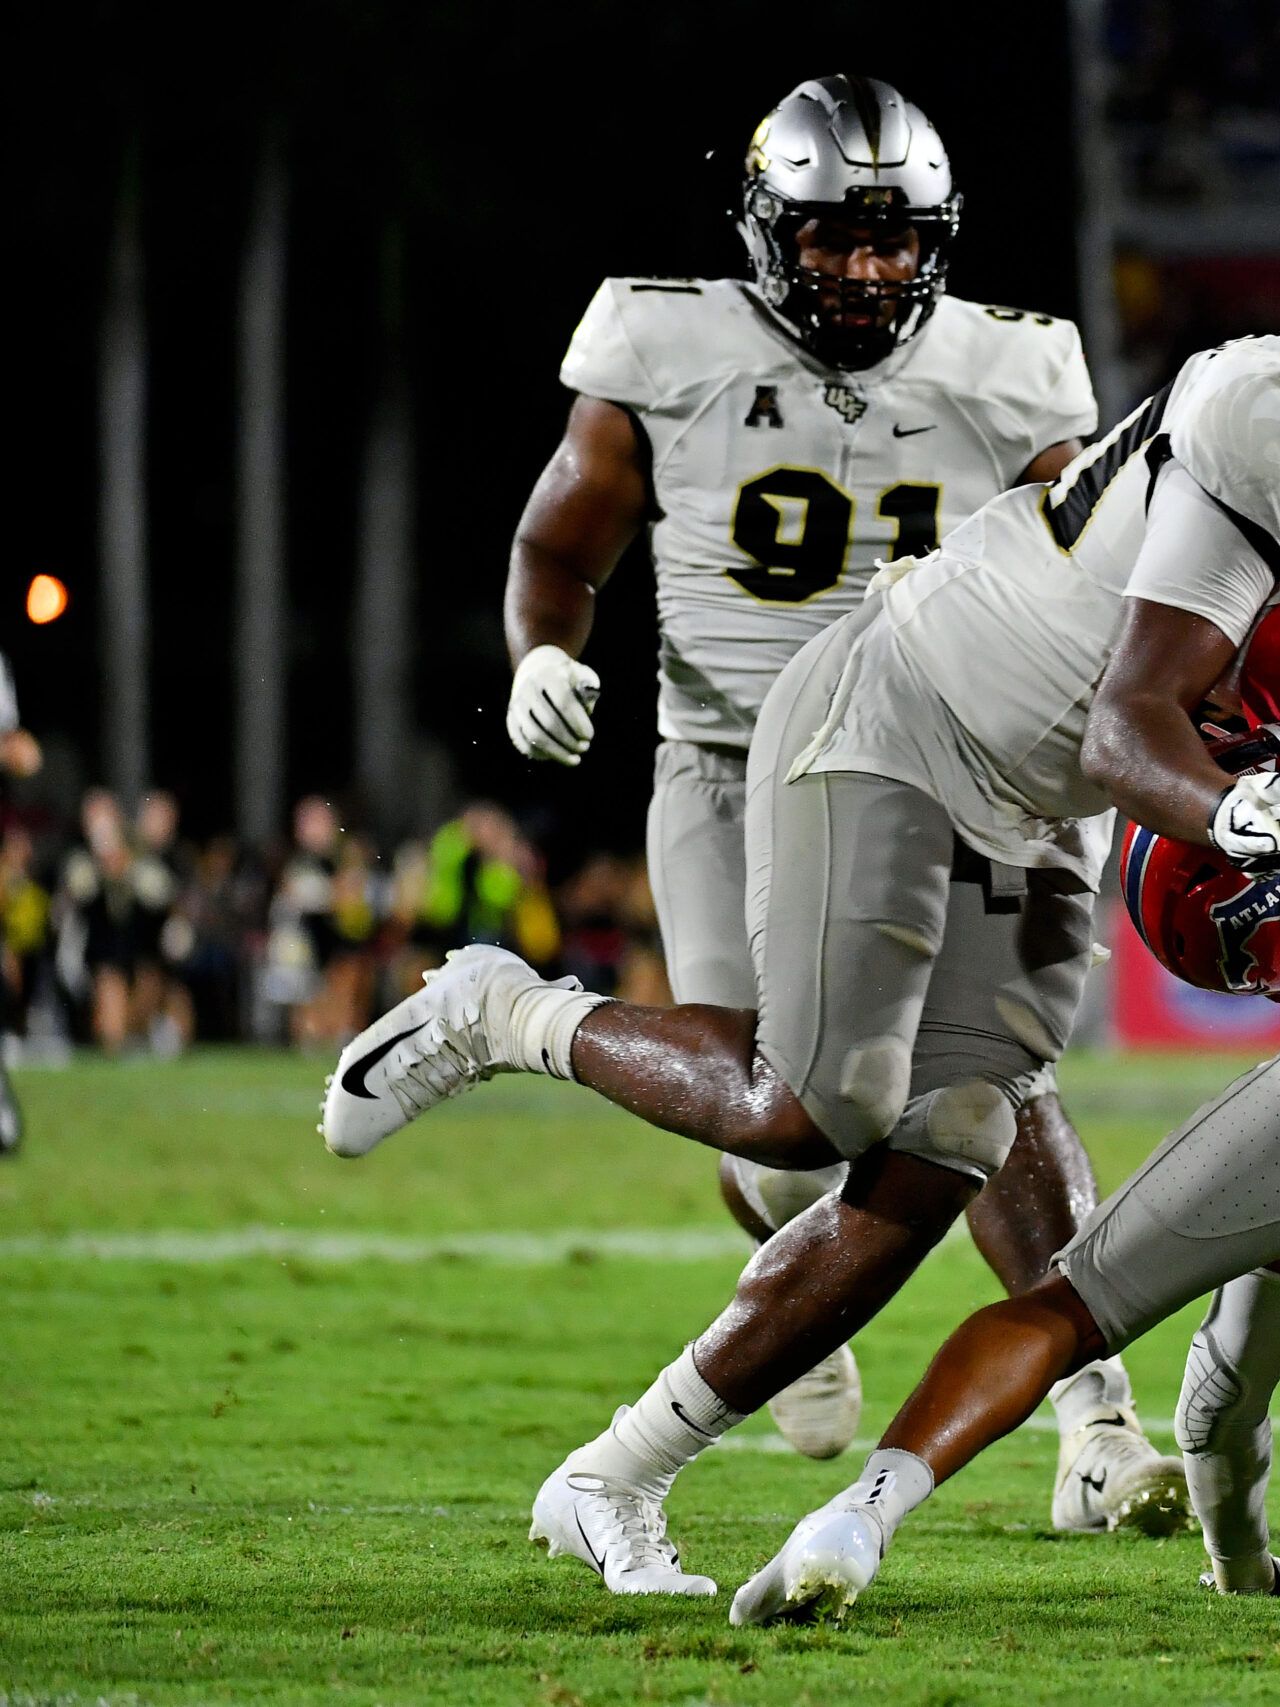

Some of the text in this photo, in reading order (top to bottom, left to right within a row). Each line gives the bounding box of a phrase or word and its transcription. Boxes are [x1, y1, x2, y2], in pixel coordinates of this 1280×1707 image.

[745, 385, 784, 428] A
[825, 383, 868, 424] UCF
[725, 463, 943, 607] 91
